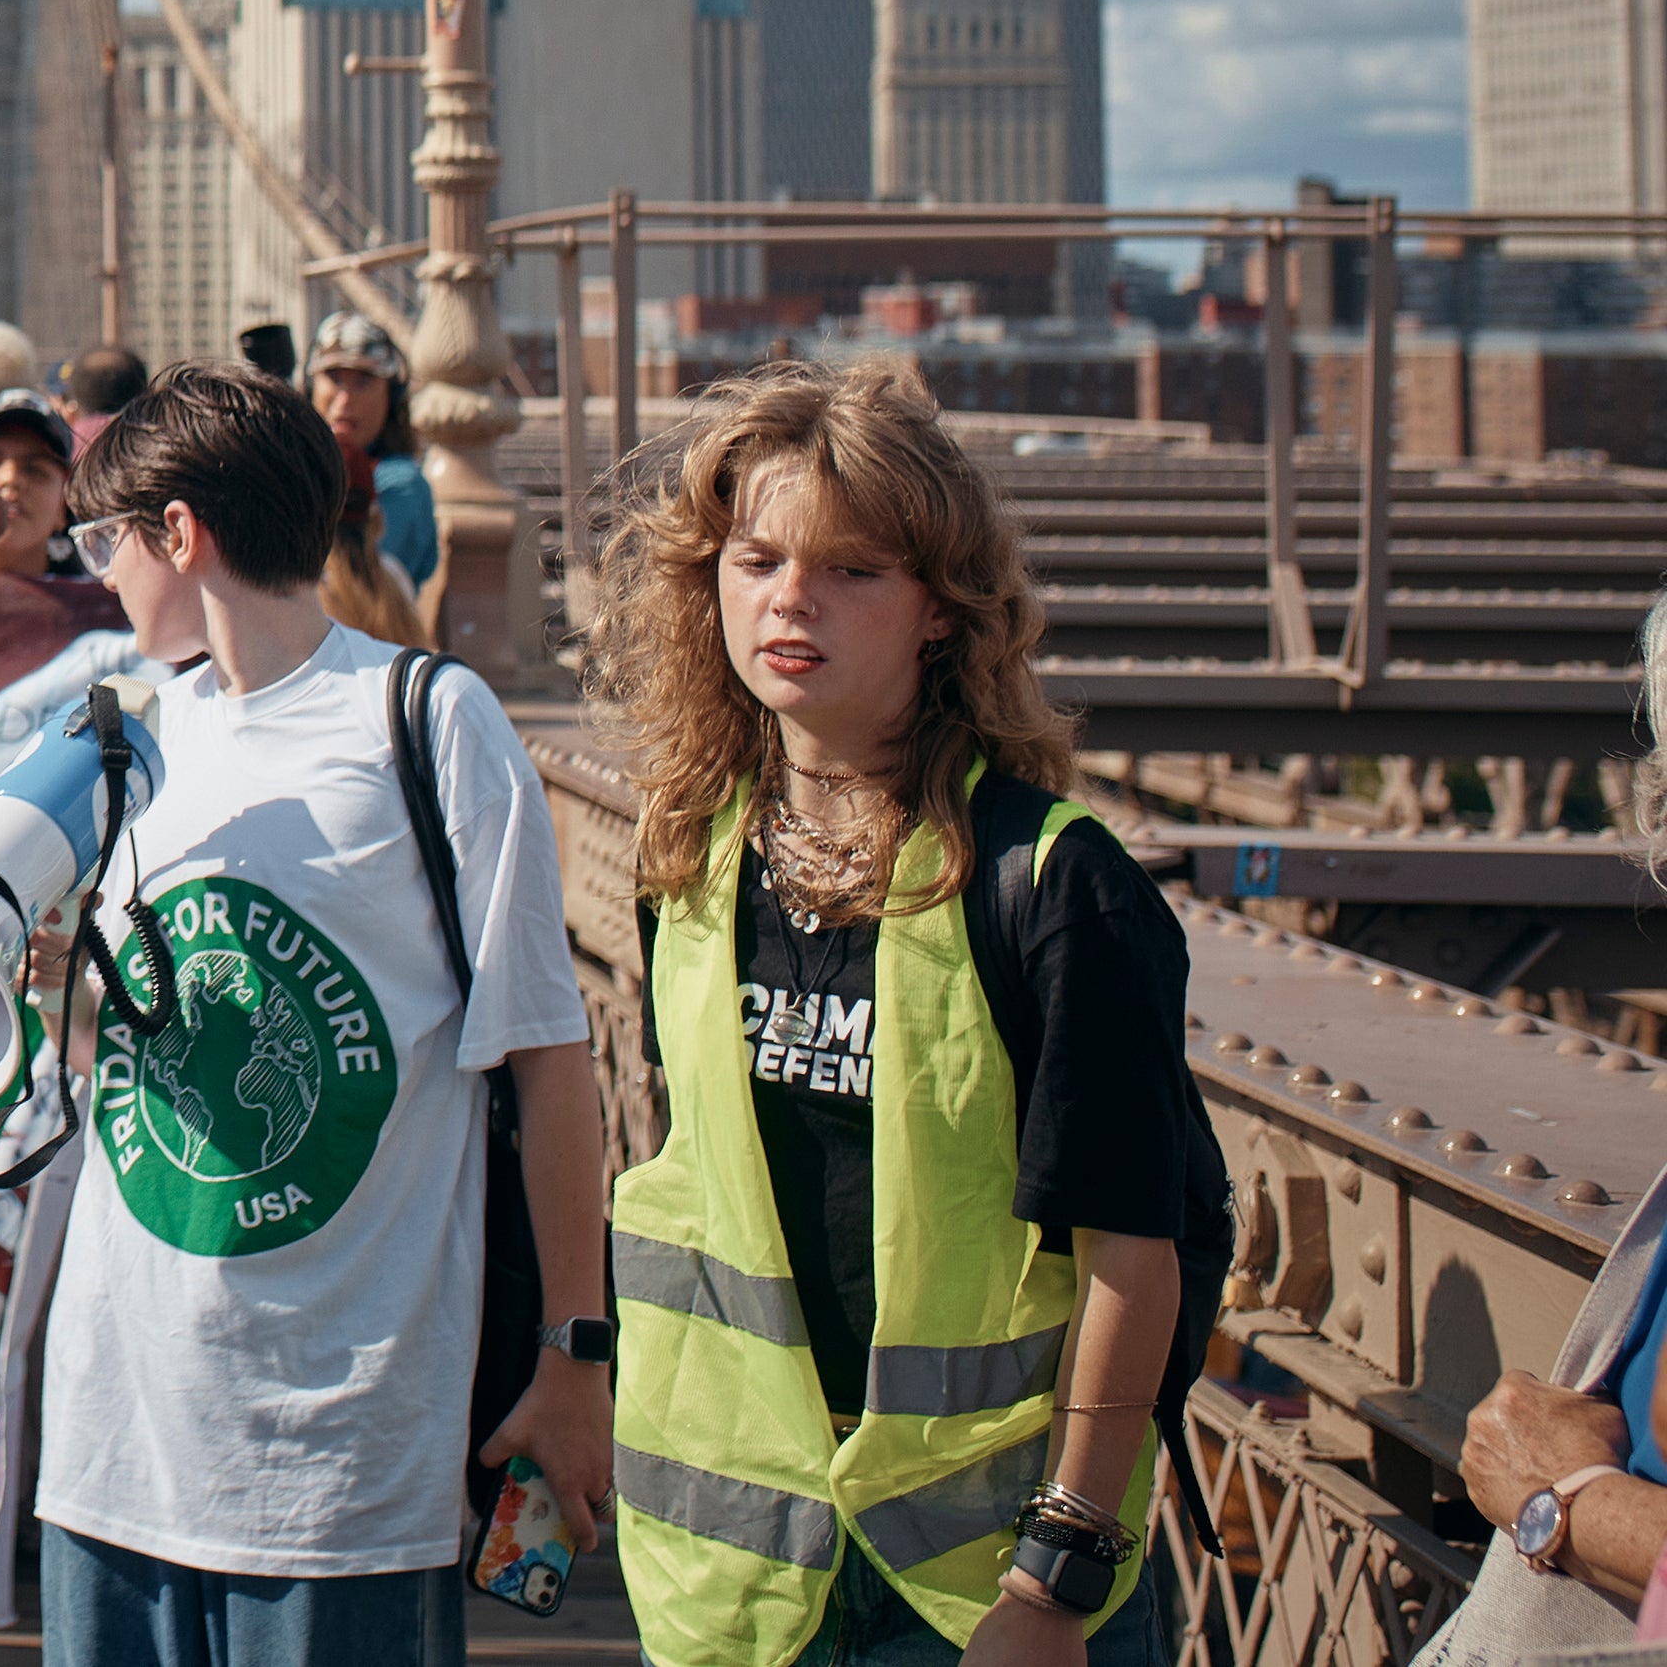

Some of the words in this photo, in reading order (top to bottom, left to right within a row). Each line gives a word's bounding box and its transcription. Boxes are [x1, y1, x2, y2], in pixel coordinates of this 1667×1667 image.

[156, 891, 234, 957] FOR
[243, 900, 381, 1075] FUTURE
[234, 1182, 313, 1229] USA
